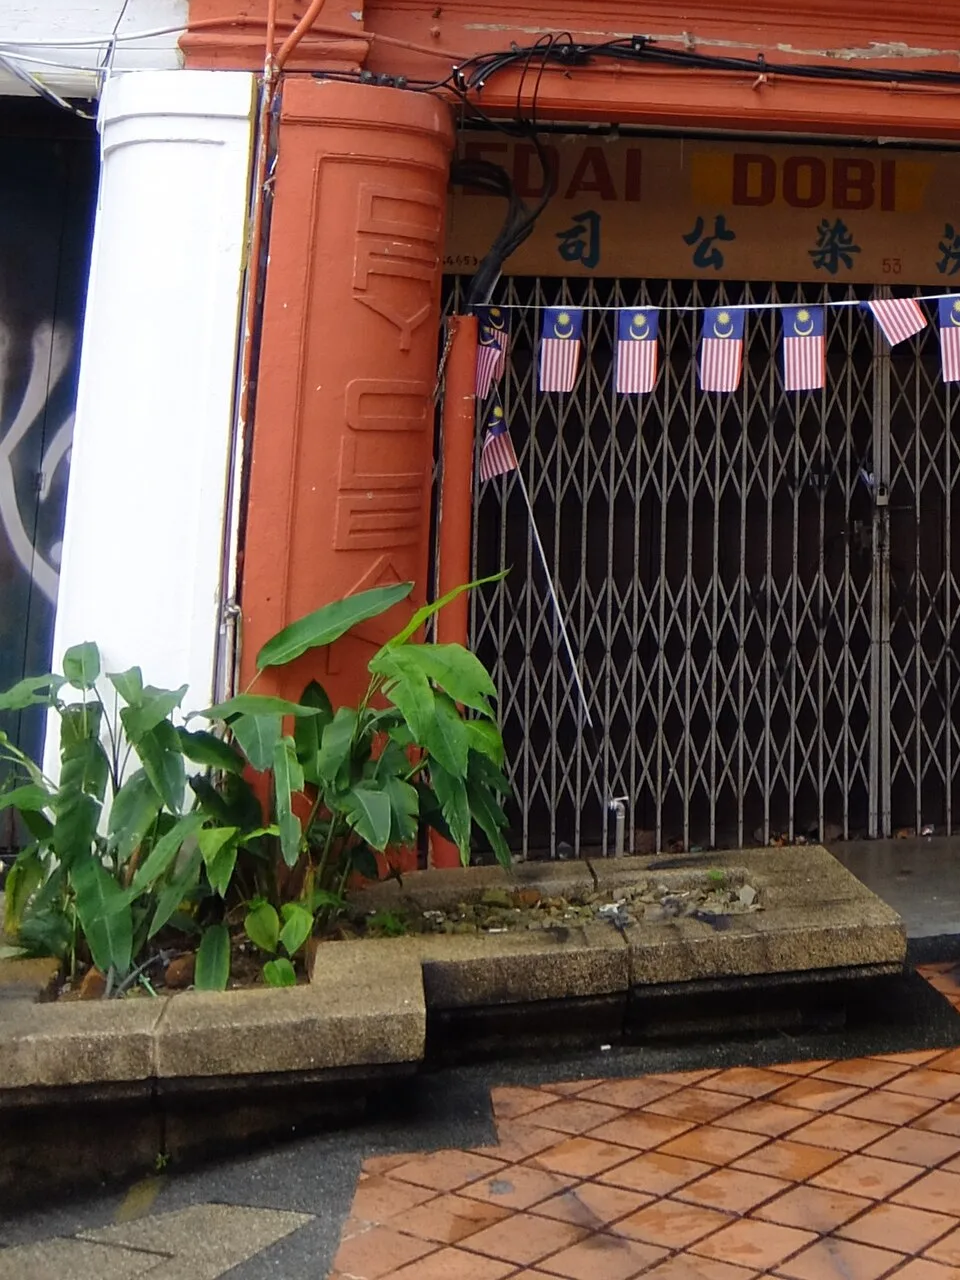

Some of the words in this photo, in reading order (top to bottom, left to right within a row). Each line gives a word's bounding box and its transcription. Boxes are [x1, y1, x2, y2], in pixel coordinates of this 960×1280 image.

[449, 141, 642, 203] EDAI
[732, 152, 897, 213] DOBI
[882, 258, 902, 274] 53
